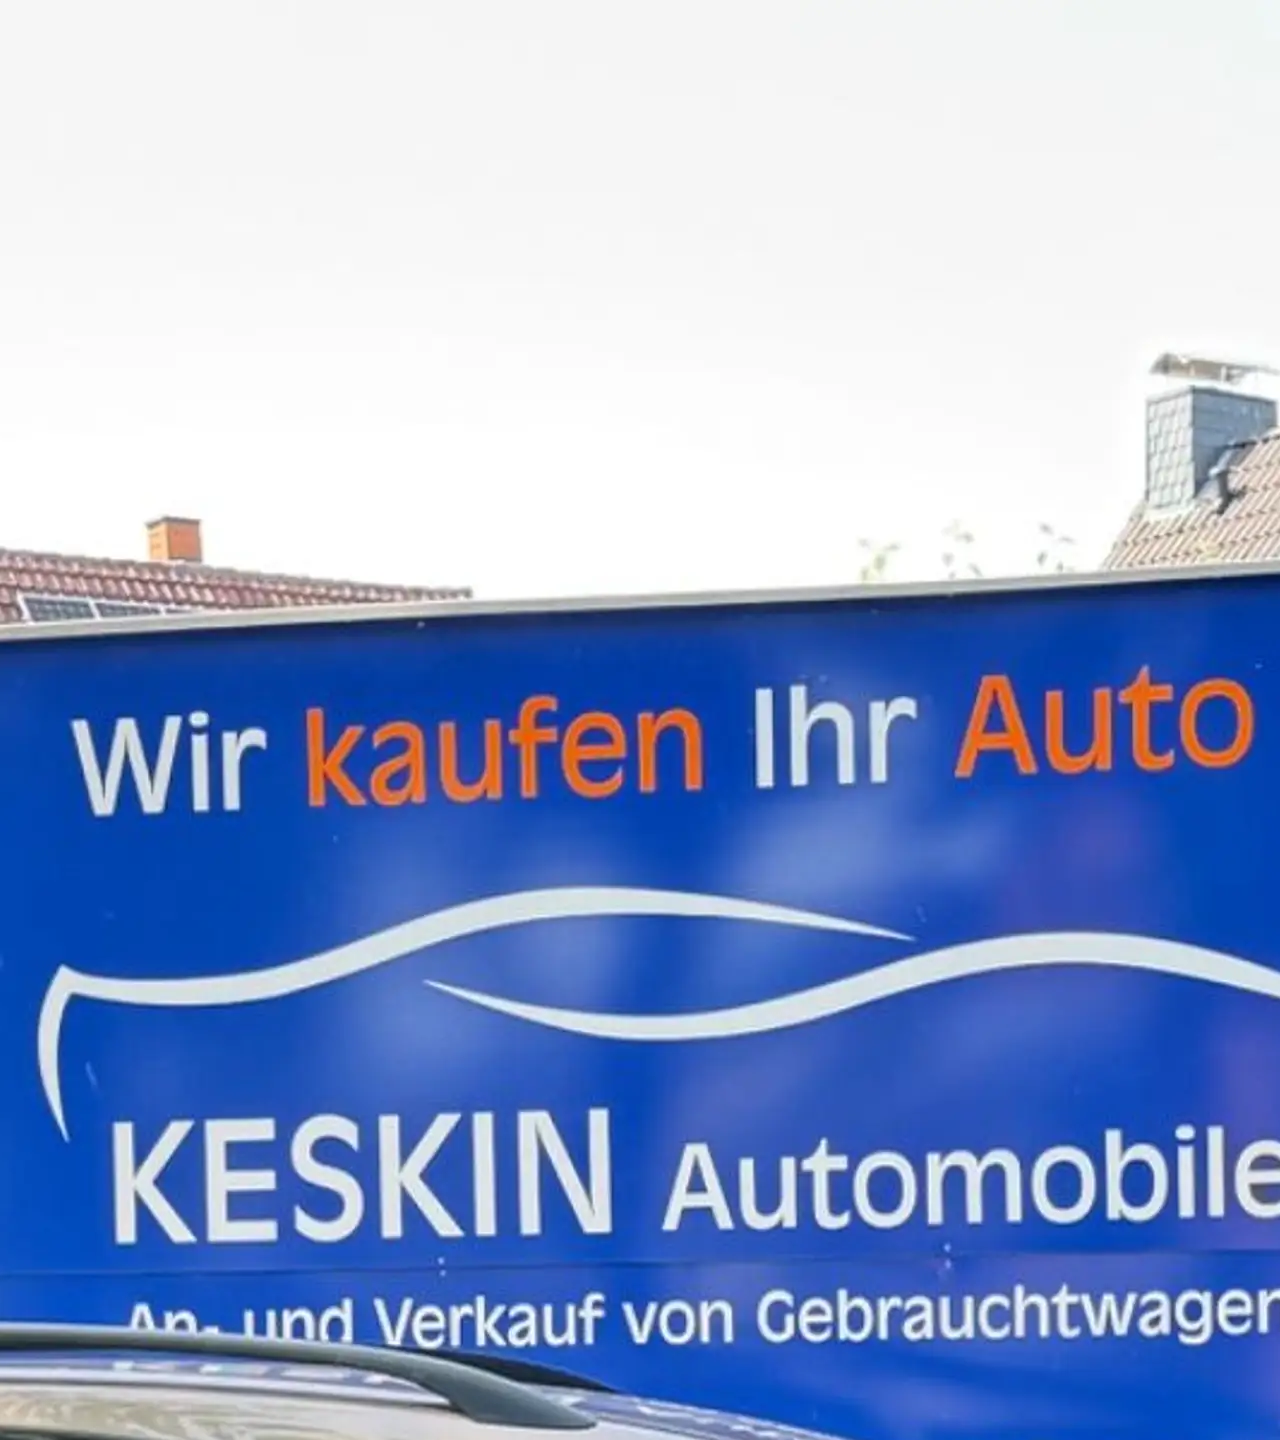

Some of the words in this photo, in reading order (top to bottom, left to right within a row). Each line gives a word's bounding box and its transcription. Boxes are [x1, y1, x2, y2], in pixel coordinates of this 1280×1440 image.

[72, 711, 267, 816] Wir
[306, 696, 703, 807] kaufen
[755, 685, 917, 788] Ihr
[954, 666, 1255, 777] Auto
[113, 1108, 613, 1246] KESKIN
[243, 1297, 354, 1343] und
[373, 1292, 605, 1348] Verkauf
[622, 1299, 735, 1345] von
